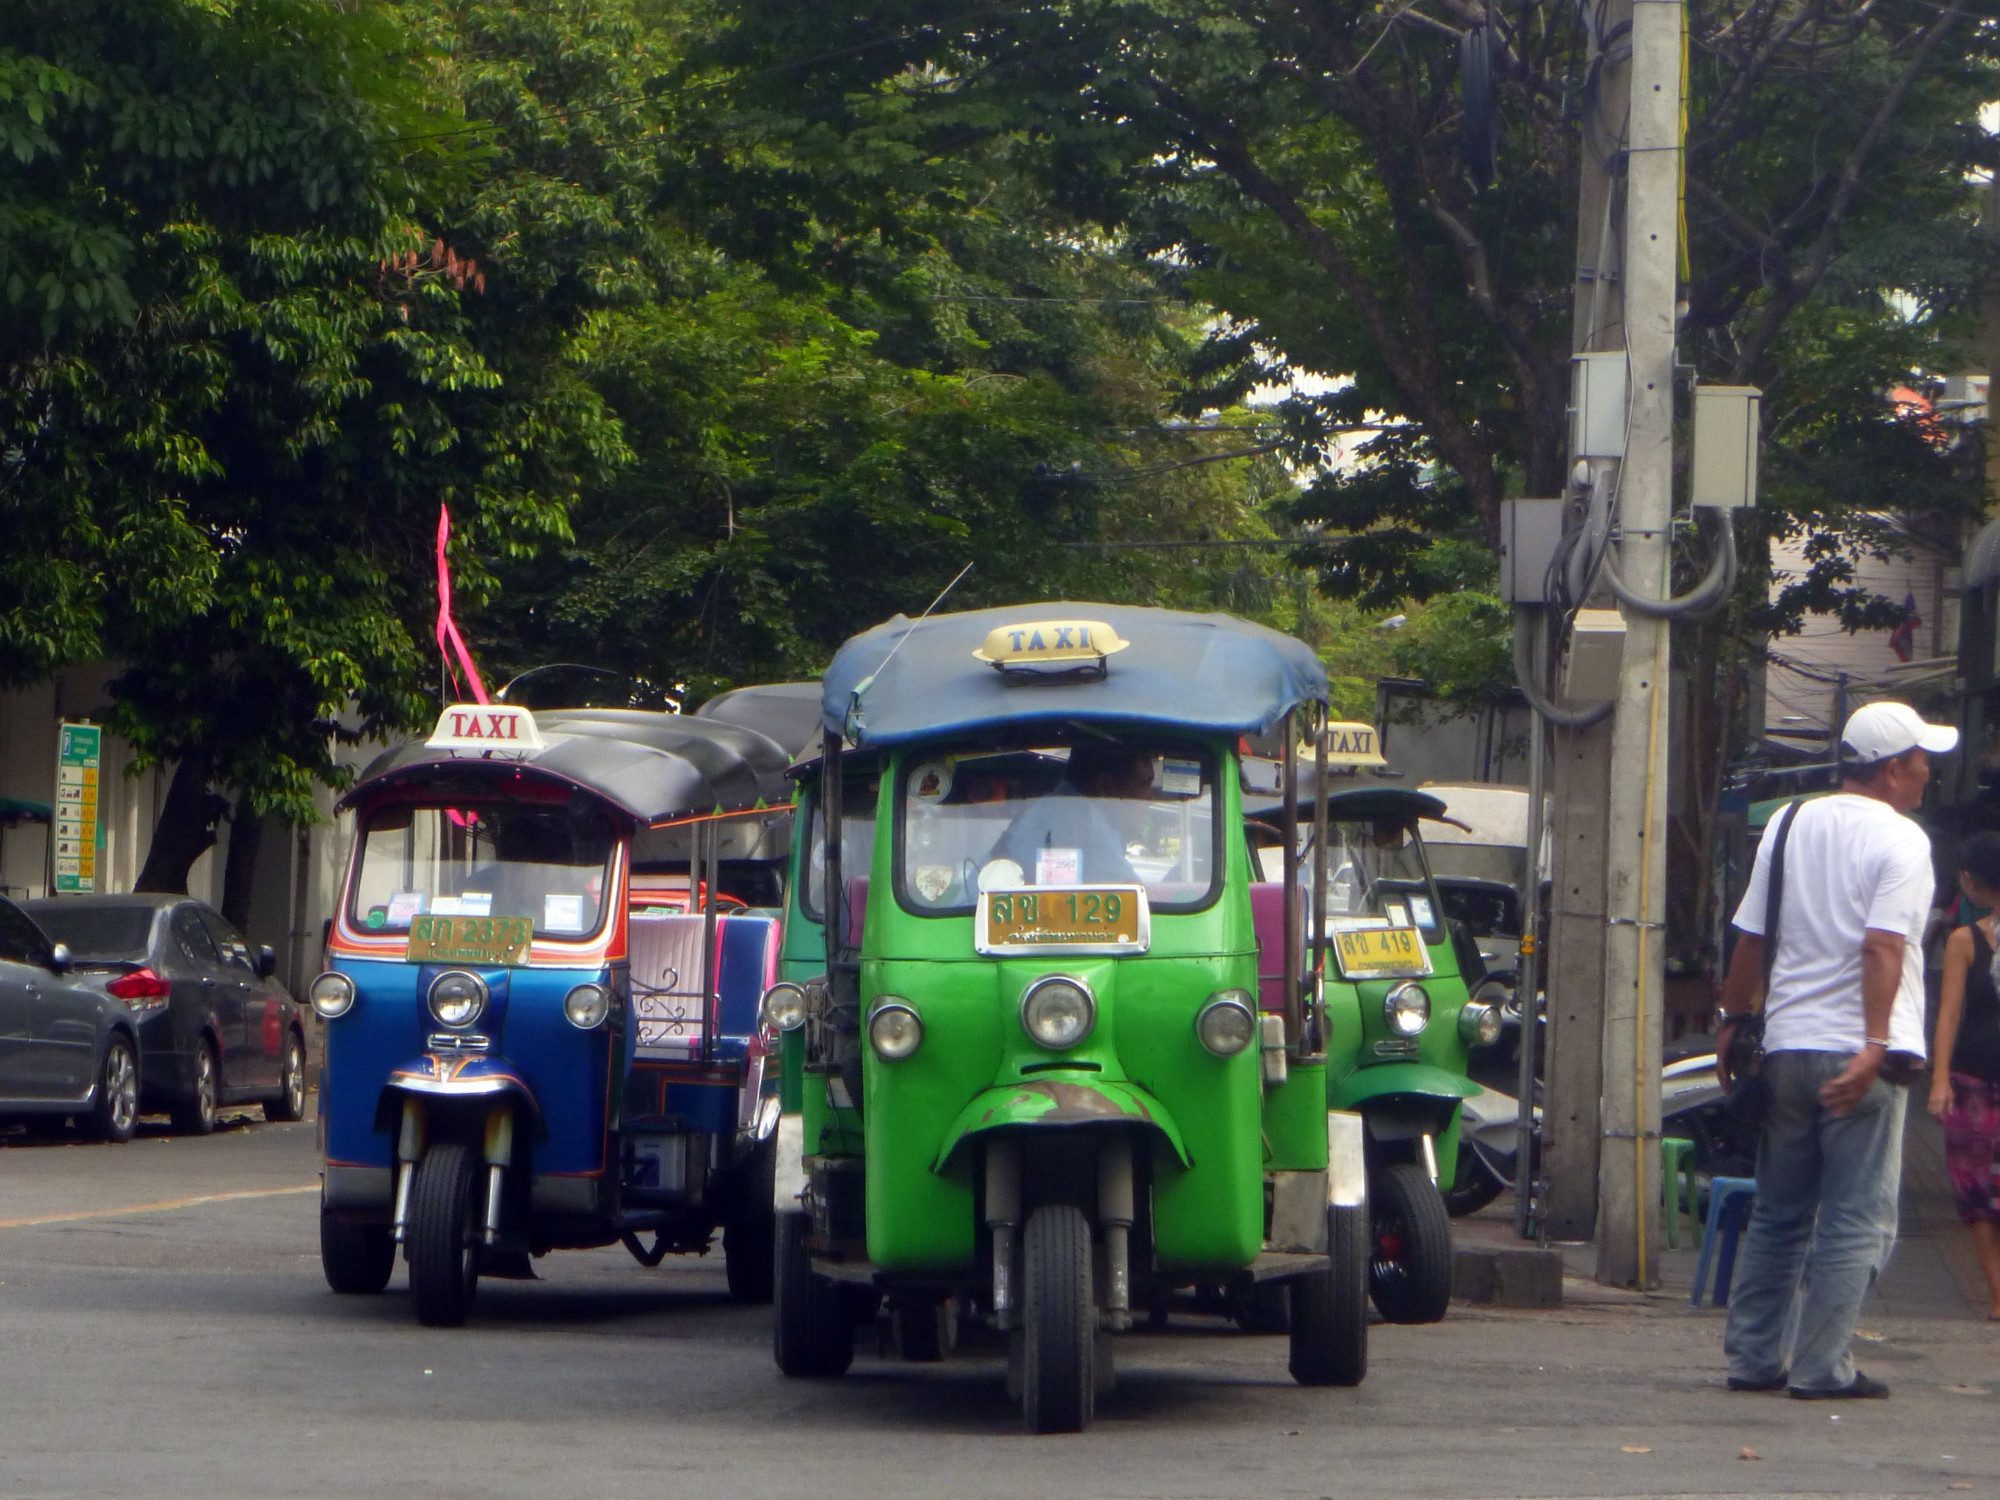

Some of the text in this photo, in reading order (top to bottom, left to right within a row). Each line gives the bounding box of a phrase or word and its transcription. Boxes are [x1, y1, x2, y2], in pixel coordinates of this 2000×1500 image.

[1008, 627, 1090, 652] TAXI
[450, 713, 518, 739] TAXI
[1327, 731, 1372, 753] TAXI
[993, 893, 1122, 924] สข 129
[463, 919, 526, 945] 2373
[1381, 931, 1411, 954] 419
